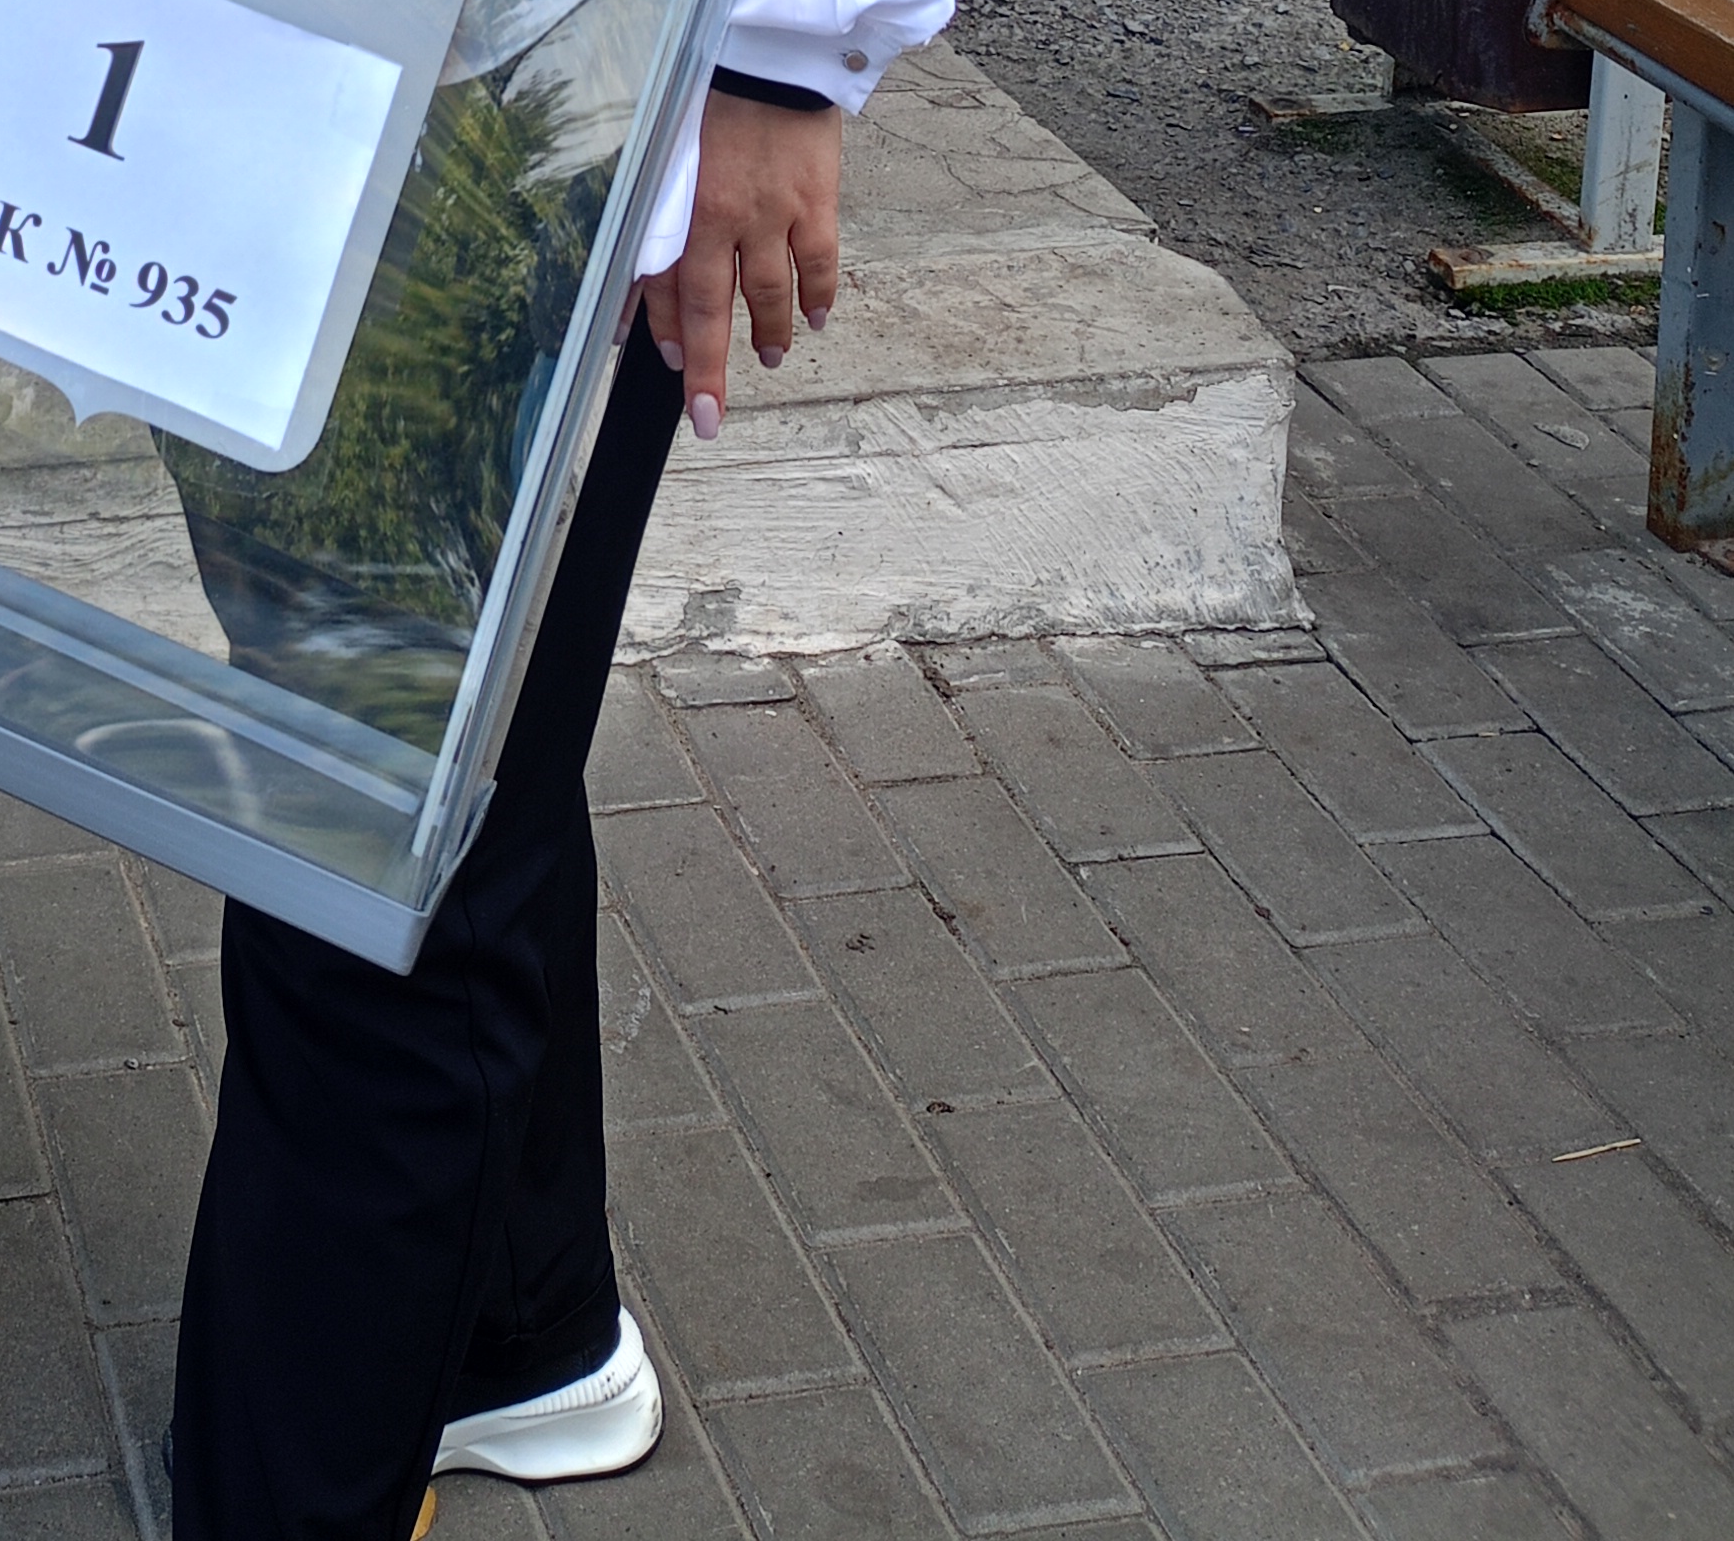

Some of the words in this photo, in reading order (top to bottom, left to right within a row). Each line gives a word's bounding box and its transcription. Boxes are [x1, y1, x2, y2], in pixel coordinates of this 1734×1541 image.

[67, 39, 145, 161] 1
[47, 227, 117, 297] №
[129, 260, 238, 340] 935
